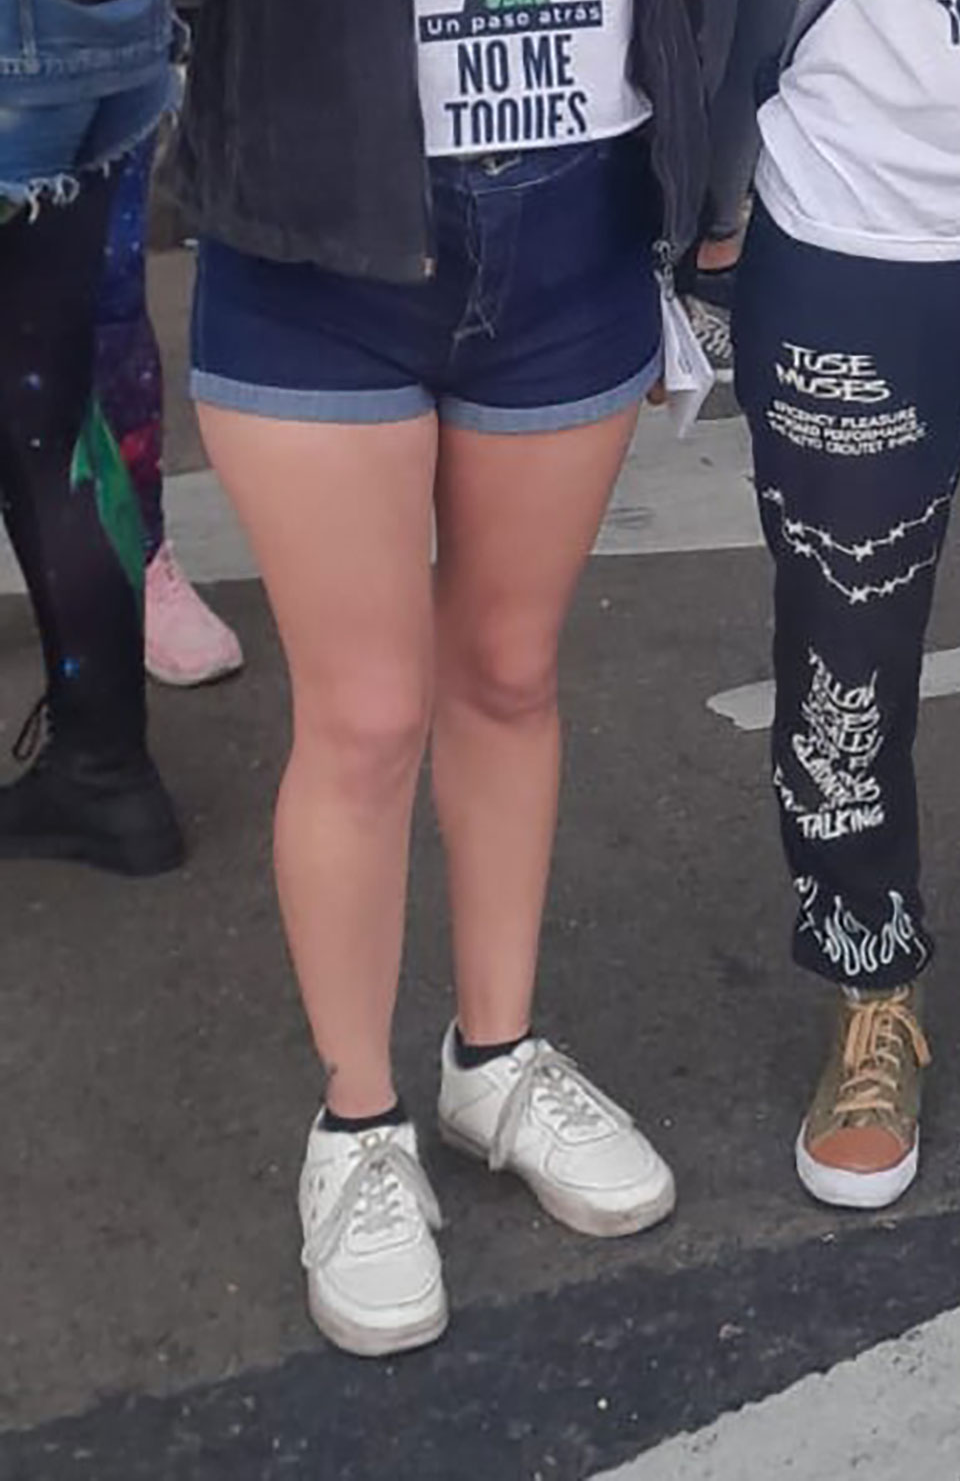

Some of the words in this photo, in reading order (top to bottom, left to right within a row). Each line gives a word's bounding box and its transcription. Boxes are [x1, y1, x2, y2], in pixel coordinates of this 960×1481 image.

[427, 18, 460, 35] Un
[471, 12, 530, 33] paso
[457, 40, 510, 95] NO
[522, 34, 574, 90] ME
[796, 804, 885, 840] TALKING
